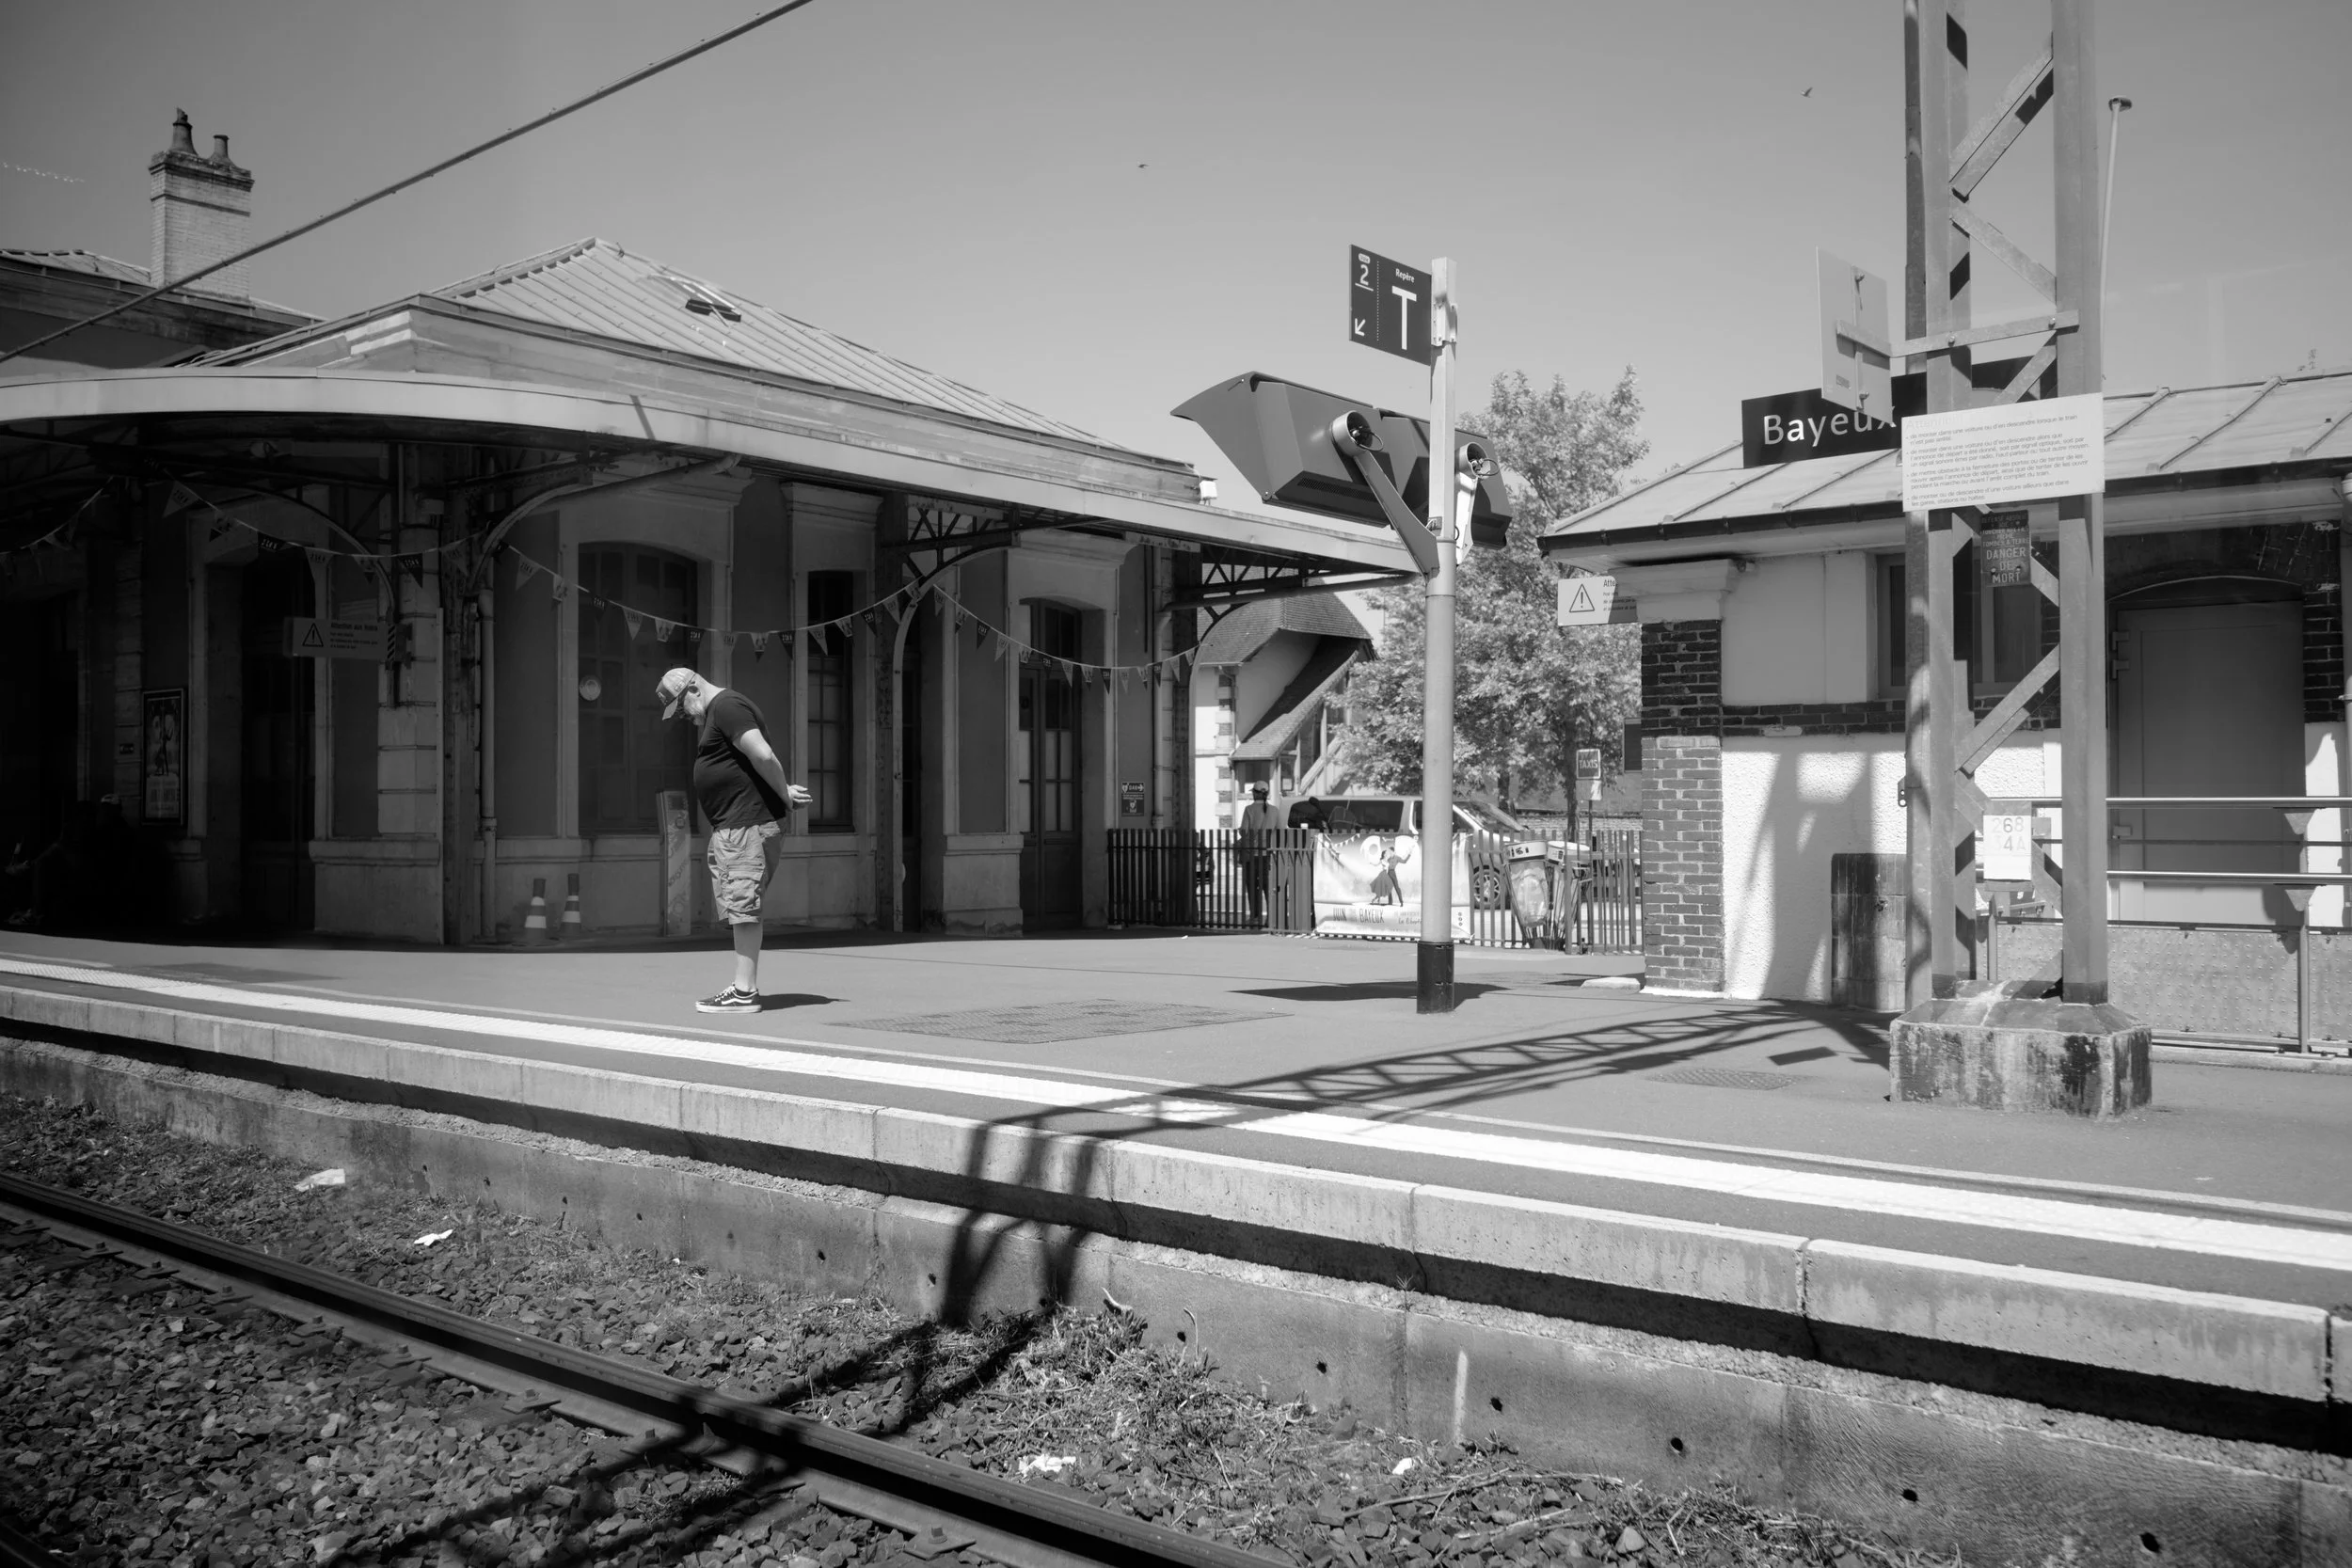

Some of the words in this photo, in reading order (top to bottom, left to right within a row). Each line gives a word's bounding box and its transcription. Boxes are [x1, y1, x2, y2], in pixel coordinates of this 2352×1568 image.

[1359, 264, 1369, 286] 2
[1395, 268, 1415, 283] Repère
[1391, 285, 1417, 351] T
[1986, 547, 2026, 560] DANGER
[2000, 561, 2015, 570] DE
[1992, 571, 2021, 584] MORT
[1579, 759, 1598, 768] TAXIS
[1991, 816, 2025, 833] 268
[1359, 908, 1385, 923] BAYEUX
